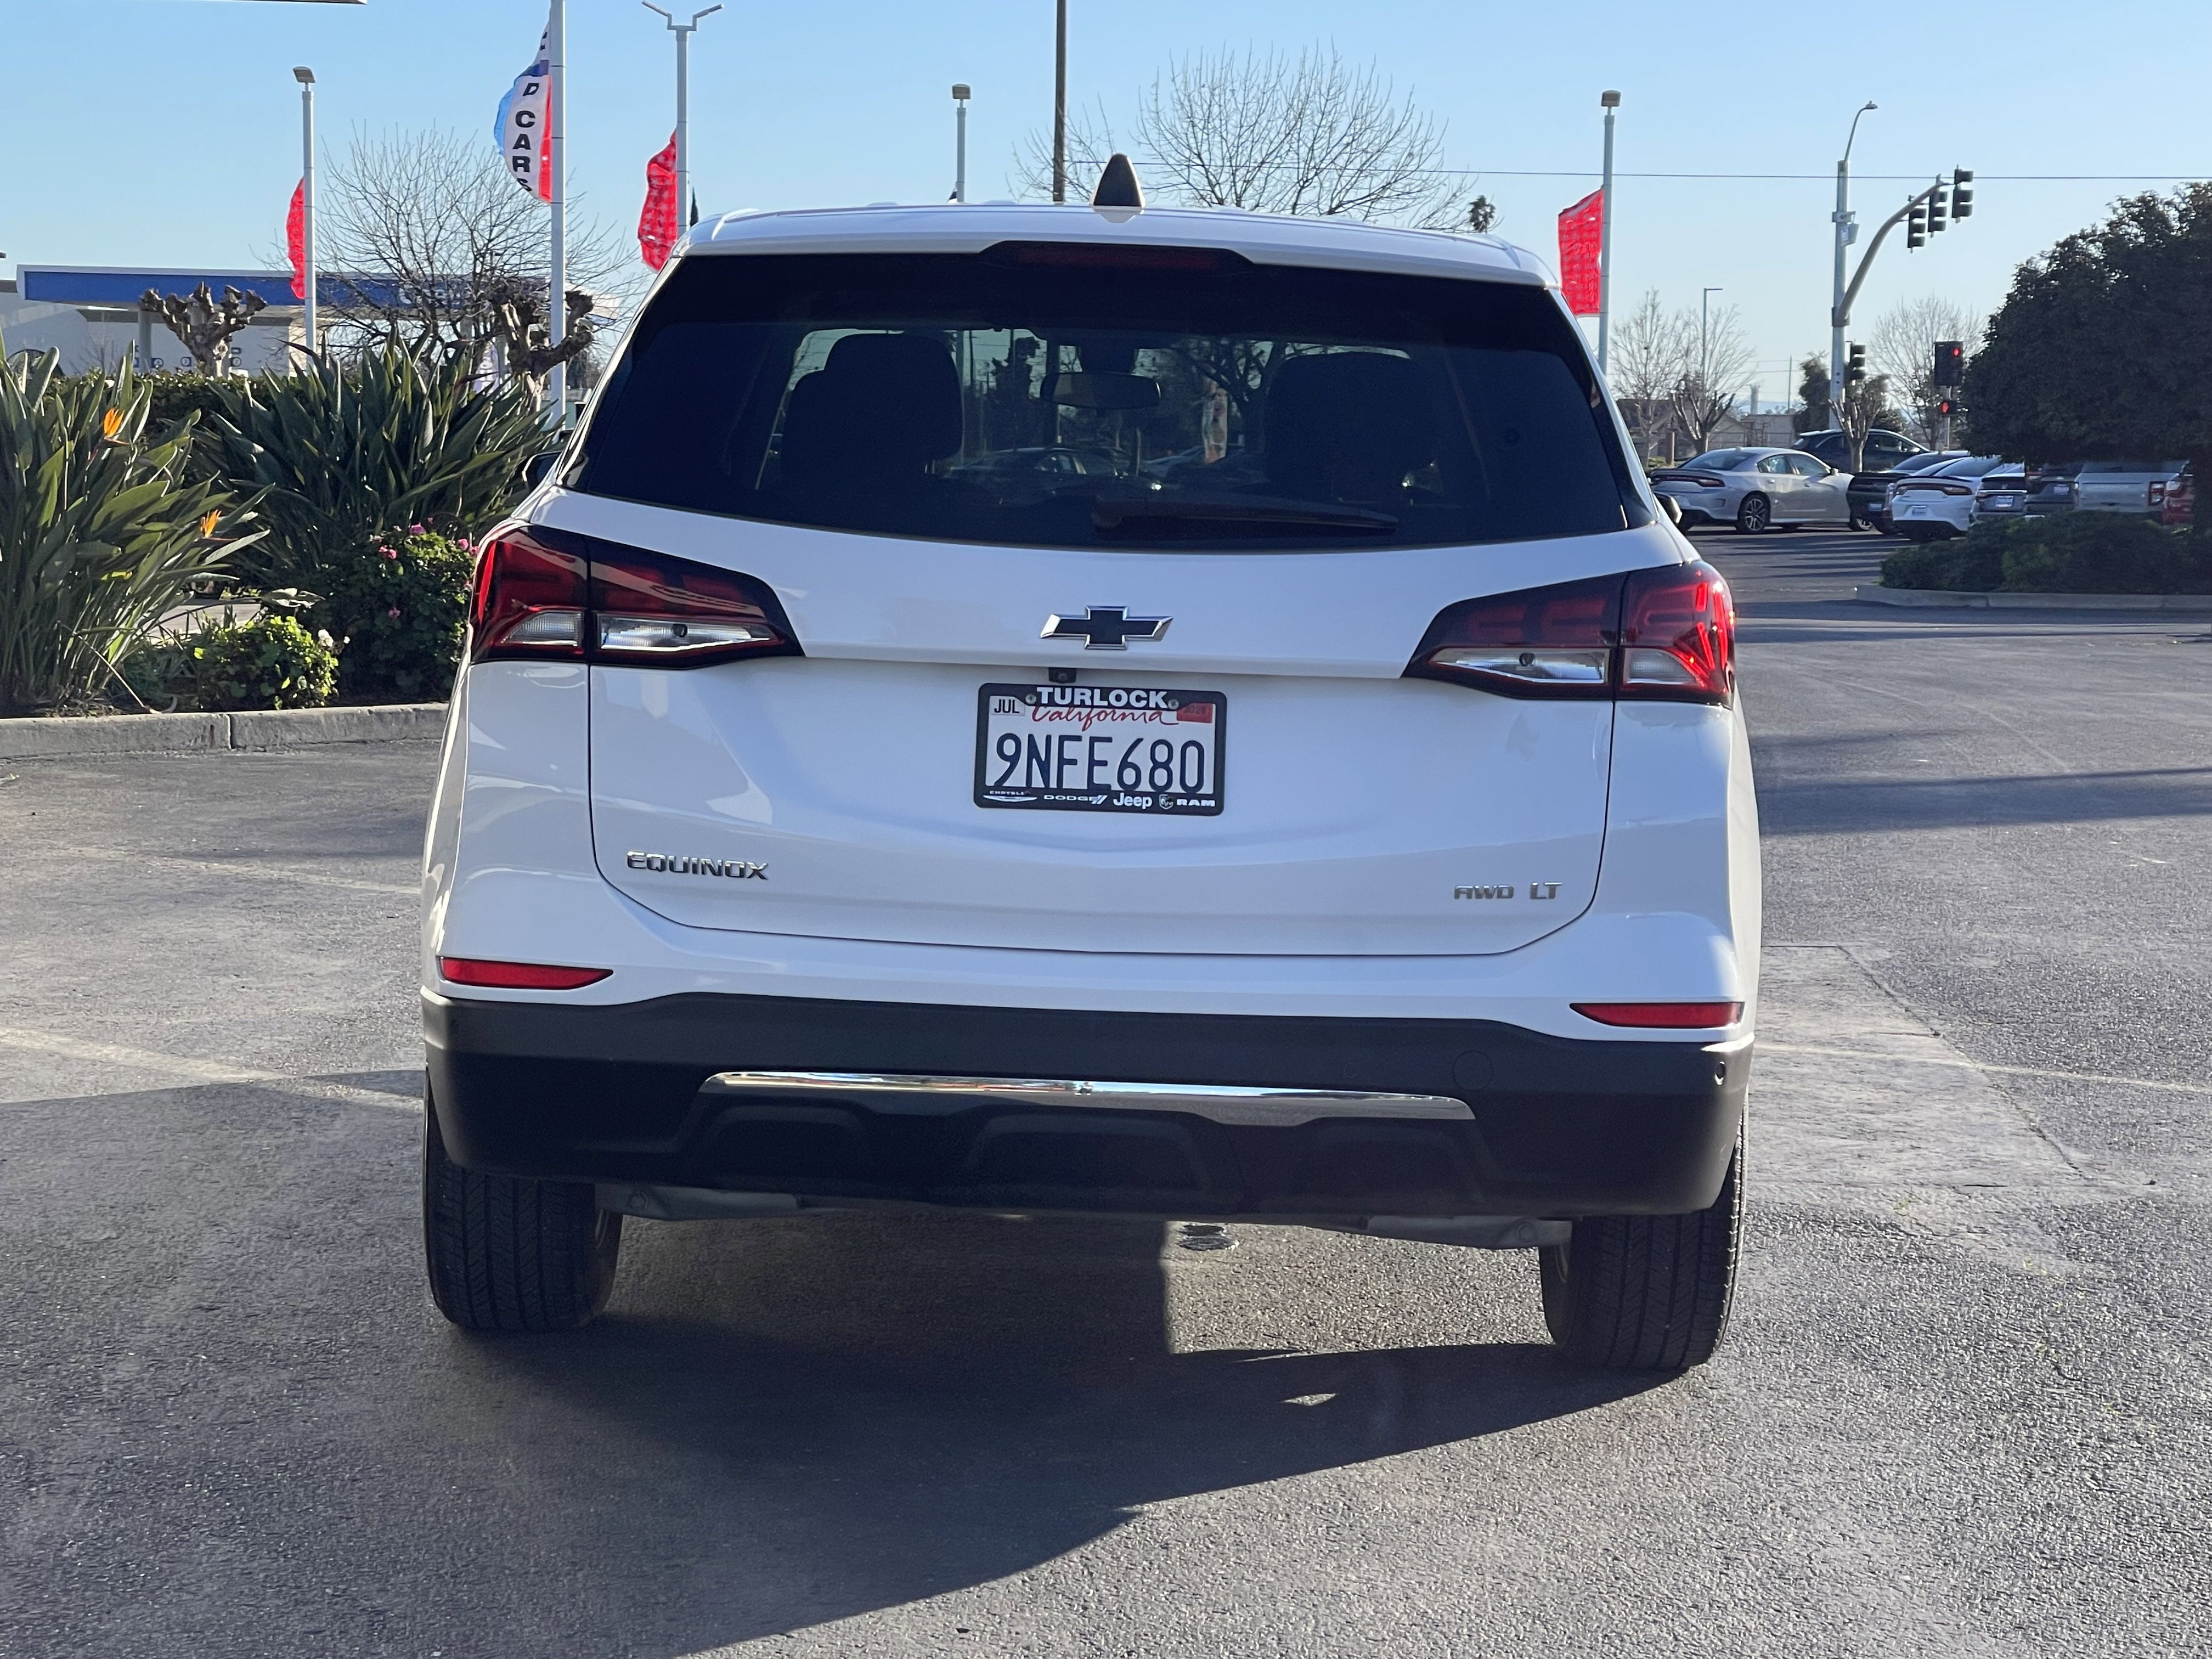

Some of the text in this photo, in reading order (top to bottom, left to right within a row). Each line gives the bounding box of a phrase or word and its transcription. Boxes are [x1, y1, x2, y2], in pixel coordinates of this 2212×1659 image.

[512, 110, 536, 191] CARS
[994, 699, 1020, 714] JUL
[1036, 686, 1168, 709] TURLOCK
[1031, 706, 1179, 732] California
[994, 732, 1205, 793] 9NFE680
[1113, 792, 1152, 809] Jeep
[1177, 798, 1216, 807] RAM
[627, 851, 769, 881] EQUINOX
[1454, 882, 1562, 900] AWD LT
